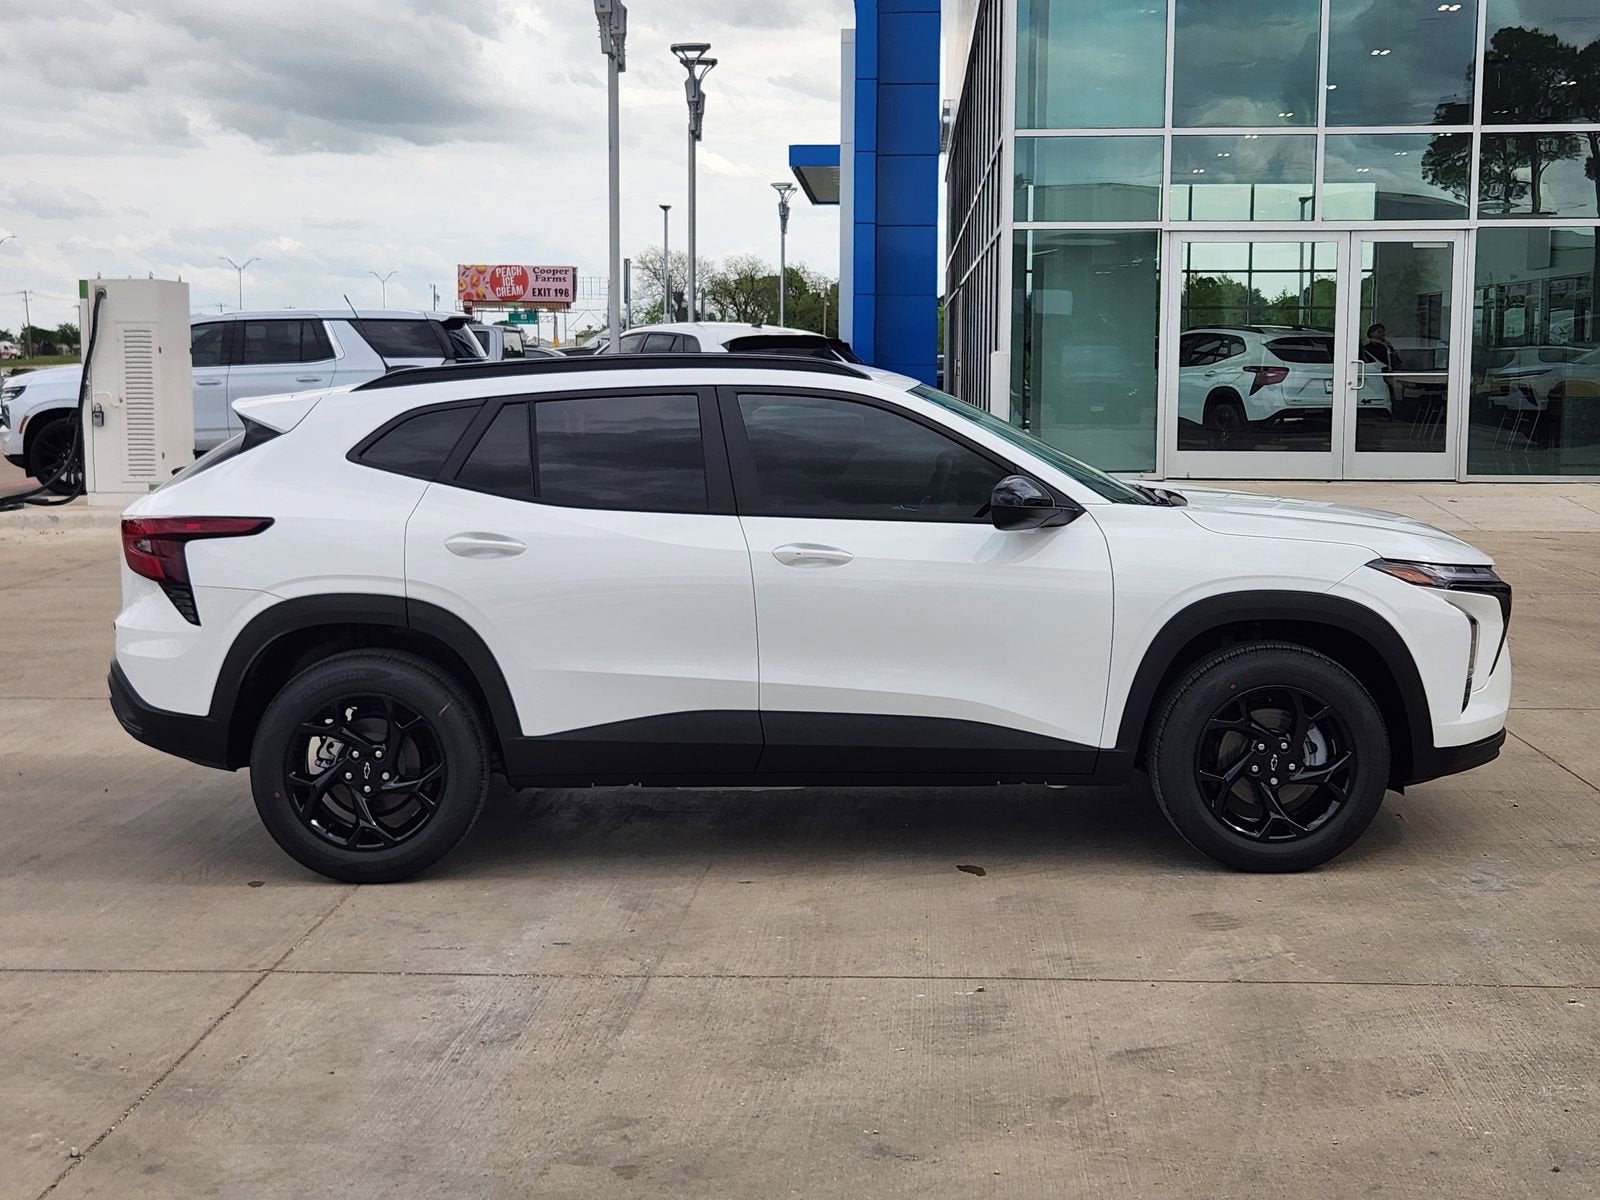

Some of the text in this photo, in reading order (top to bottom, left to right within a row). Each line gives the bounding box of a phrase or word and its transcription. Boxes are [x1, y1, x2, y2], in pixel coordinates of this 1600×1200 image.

[496, 266, 522, 277] PEACH
[533, 266, 569, 276] Cooper
[502, 276, 515, 287] ICE
[535, 274, 567, 283] Farms
[496, 285, 523, 297] CREAM
[532, 288, 570, 297] EXIT 198
